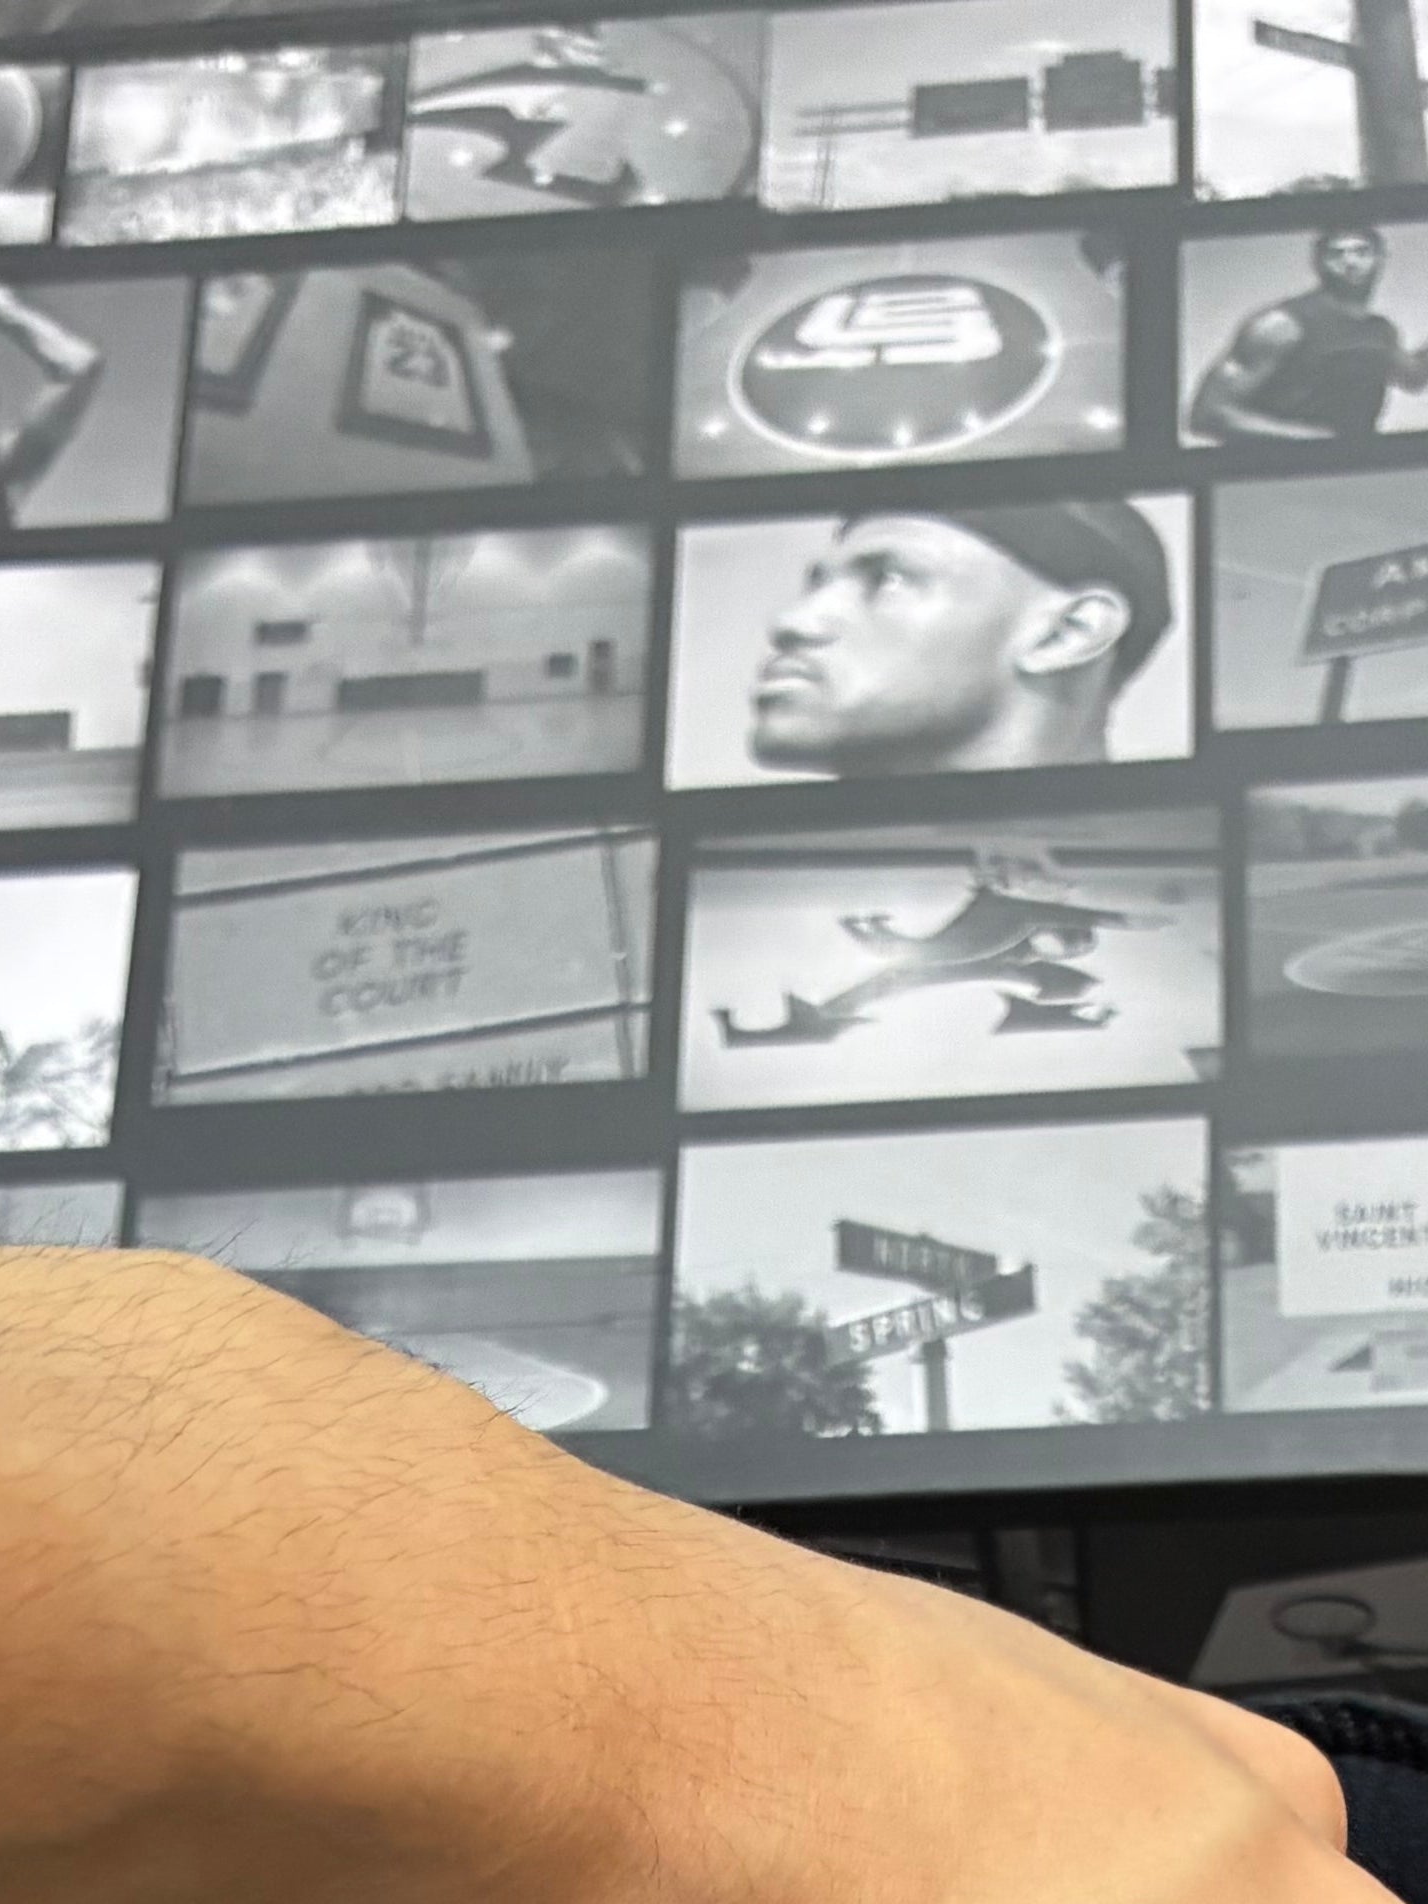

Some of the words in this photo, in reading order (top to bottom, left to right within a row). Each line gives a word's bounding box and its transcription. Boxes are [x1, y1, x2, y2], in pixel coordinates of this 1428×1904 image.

[335, 898, 438, 935] KING
[310, 945, 375, 982] OF
[390, 928, 470, 970] THE
[318, 964, 470, 1018] COURT
[1334, 1200, 1420, 1226] SAINT
[846, 1290, 984, 1352] SPRING
